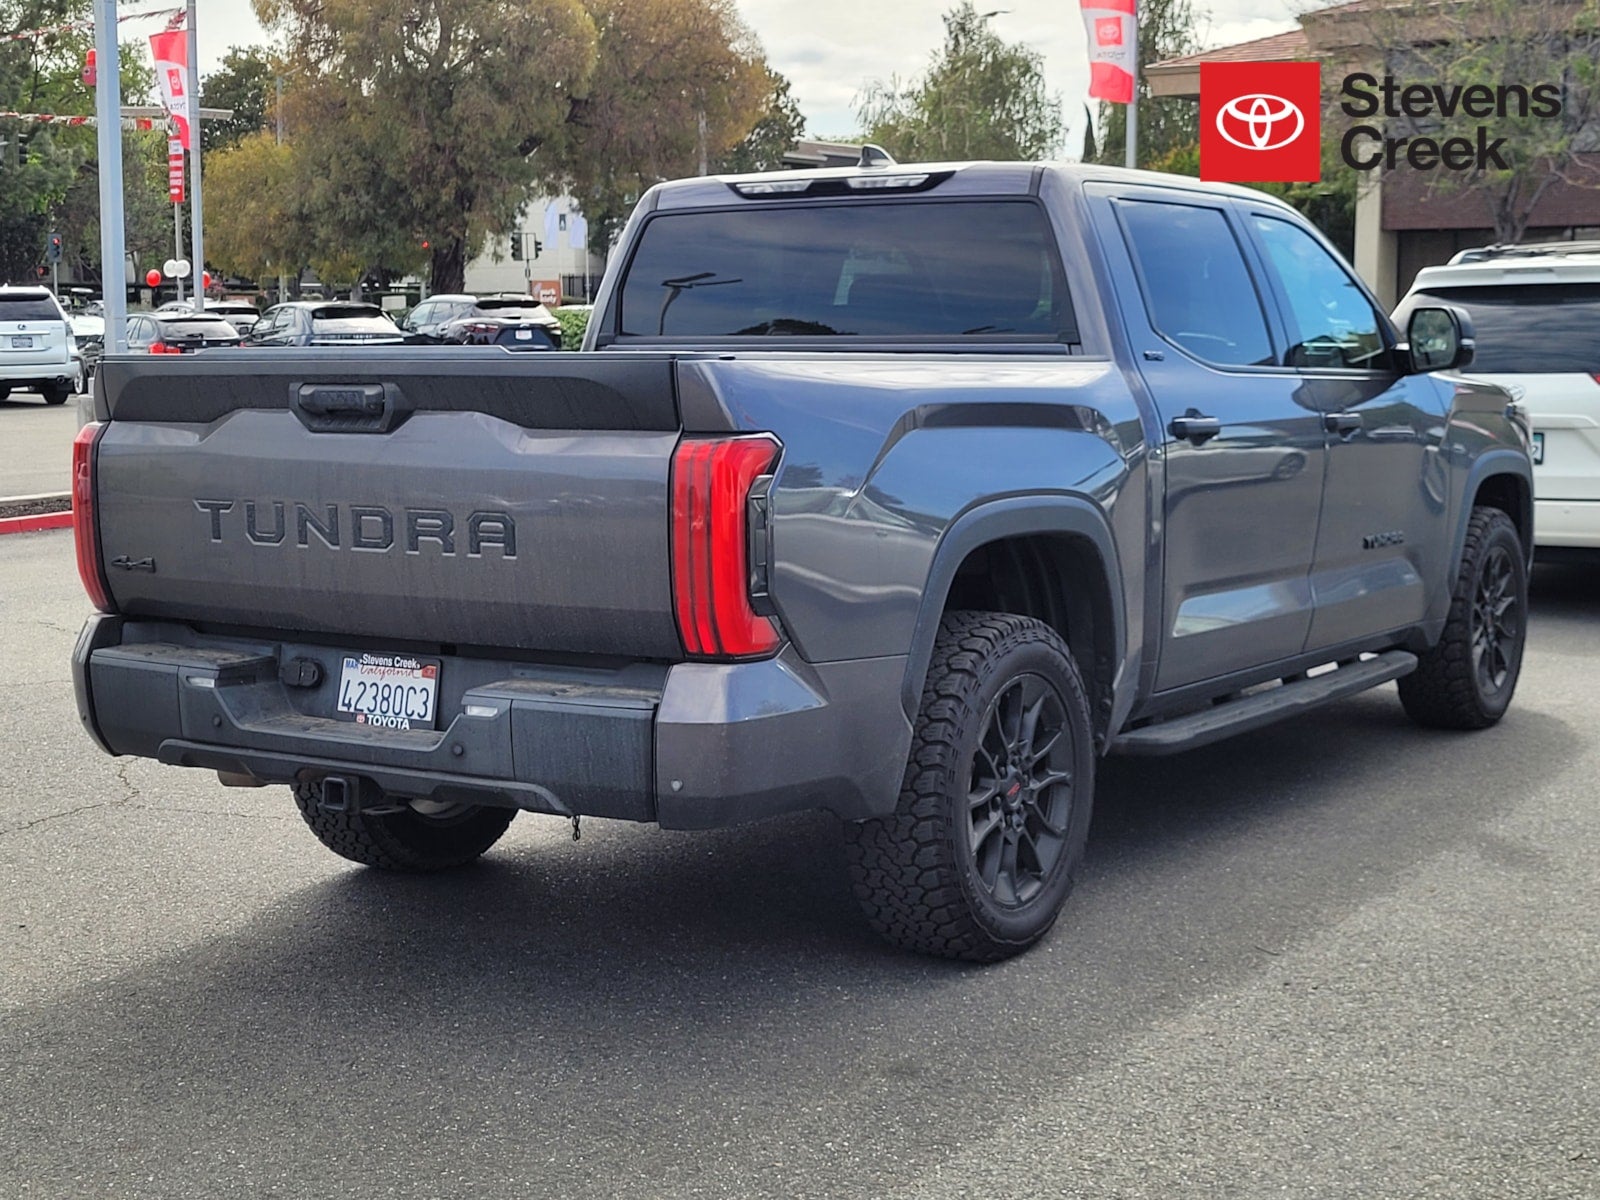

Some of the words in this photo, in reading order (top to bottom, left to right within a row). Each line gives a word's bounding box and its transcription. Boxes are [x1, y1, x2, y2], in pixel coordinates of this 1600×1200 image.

[193, 500, 518, 560] TUNDRA
[363, 653, 392, 666] Stevens
[394, 656, 417, 669] Creek
[341, 680, 430, 719] 42380C3
[367, 714, 410, 730] TOYOTA
